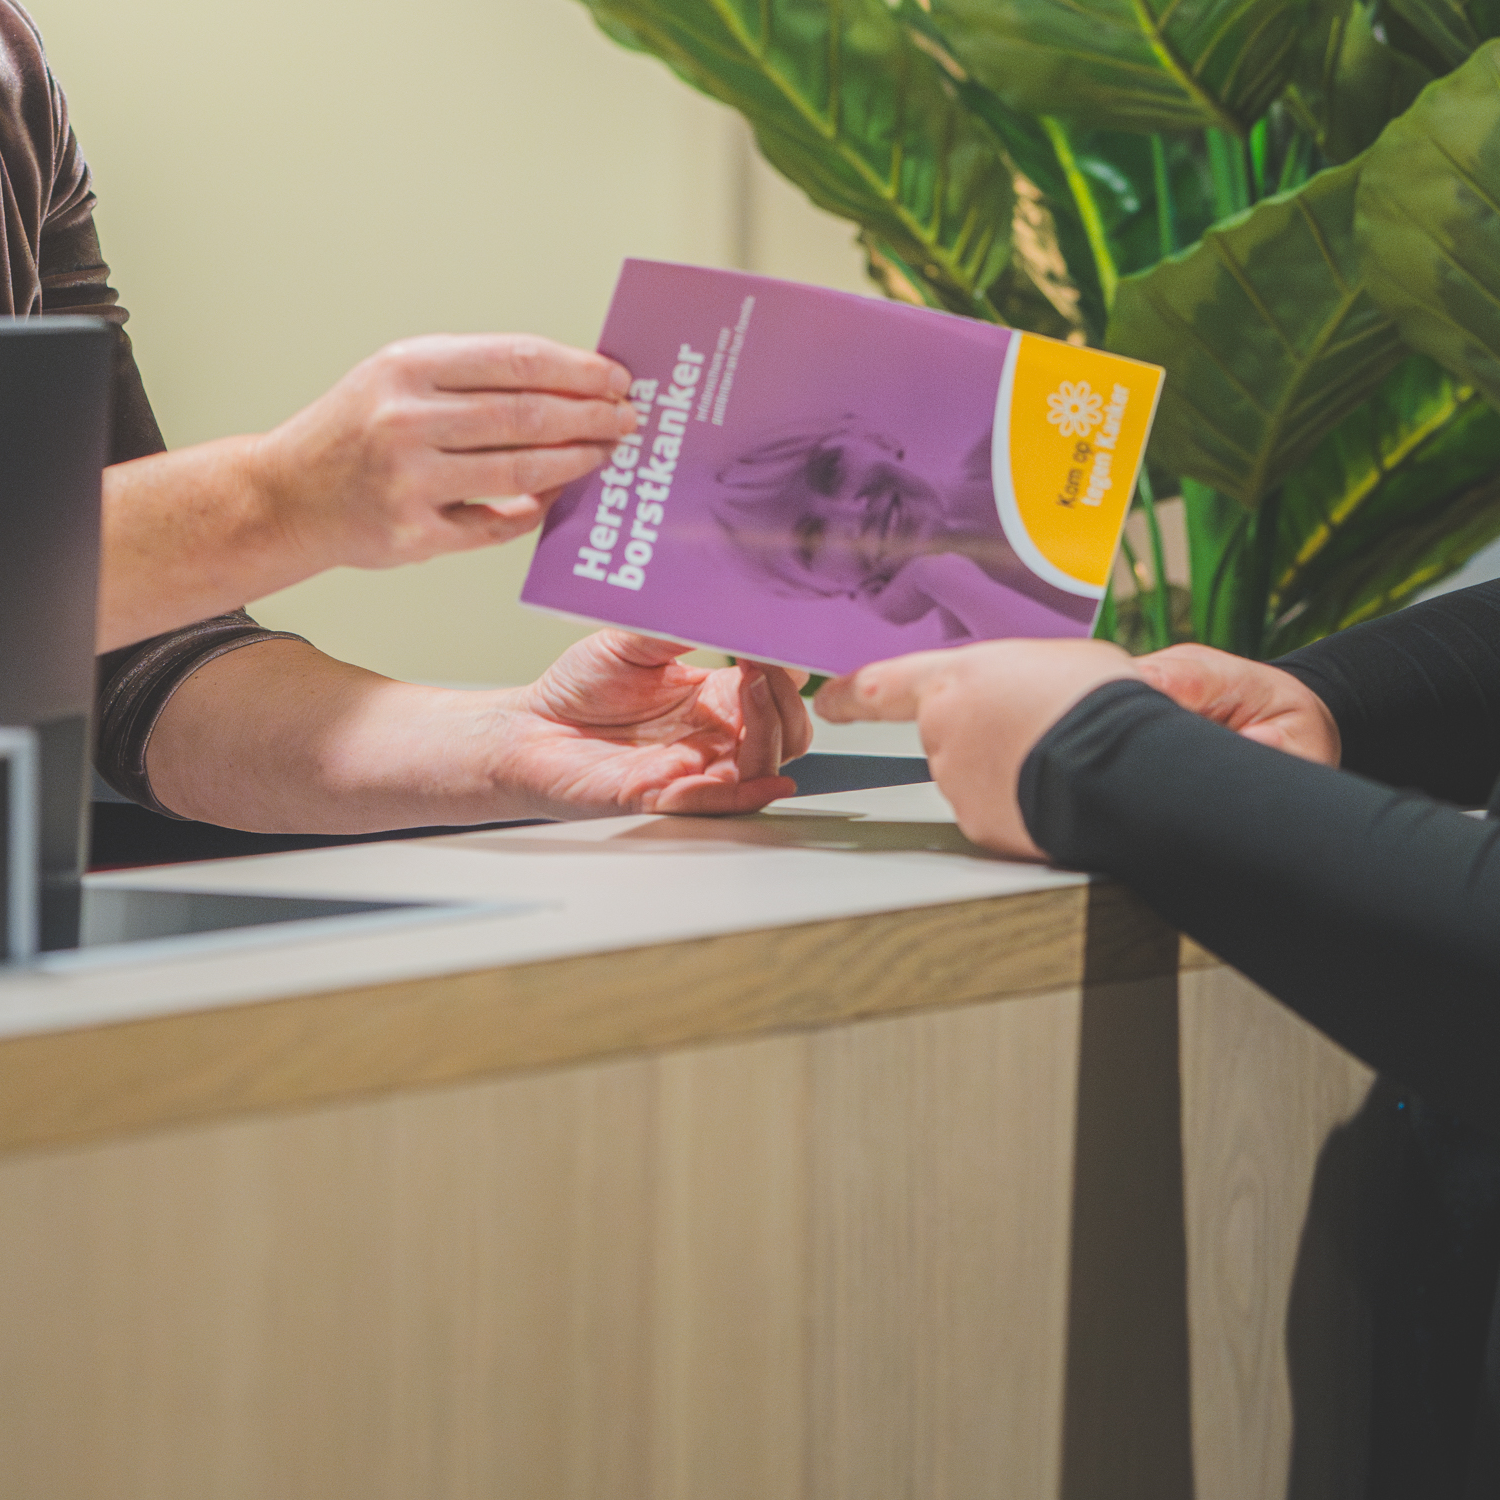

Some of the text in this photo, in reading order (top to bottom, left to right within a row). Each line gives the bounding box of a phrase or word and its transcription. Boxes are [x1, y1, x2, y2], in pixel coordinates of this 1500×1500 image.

[607, 343, 705, 591] borstkanker
[1056, 441, 1093, 509] Kom op
